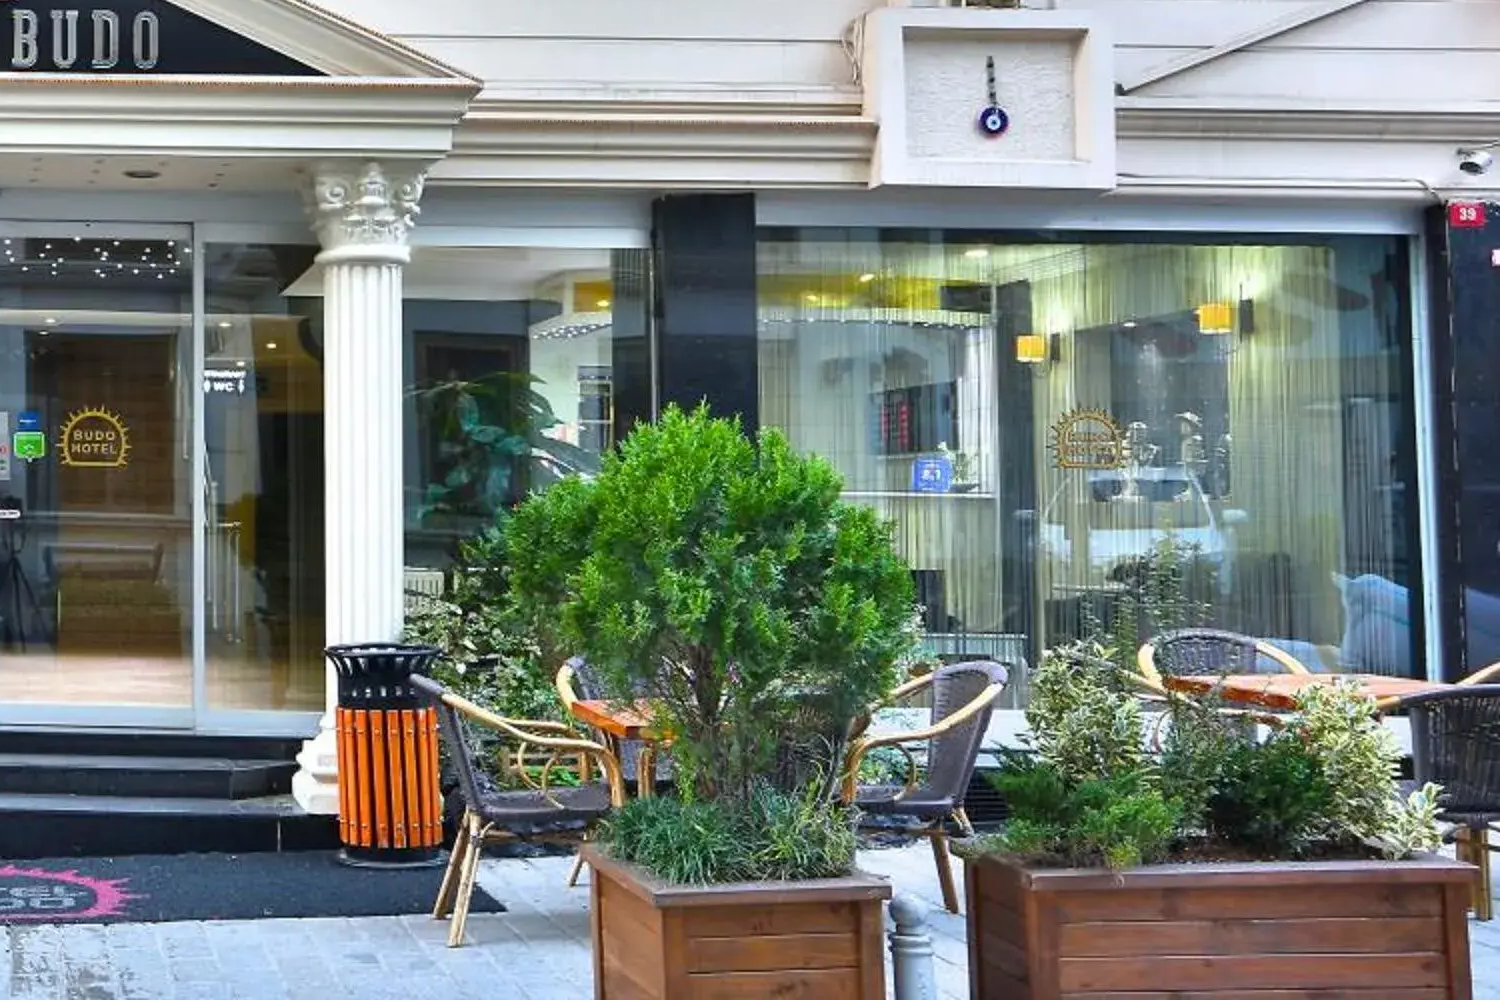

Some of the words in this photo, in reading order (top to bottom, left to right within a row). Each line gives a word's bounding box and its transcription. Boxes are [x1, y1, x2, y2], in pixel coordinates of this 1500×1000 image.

[12, 8, 160, 69] BUDO
[1459, 207, 1477, 221] 39
[213, 382, 235, 392] WC
[73, 430, 115, 440] BUDO
[71, 443, 117, 454] HOTEL
